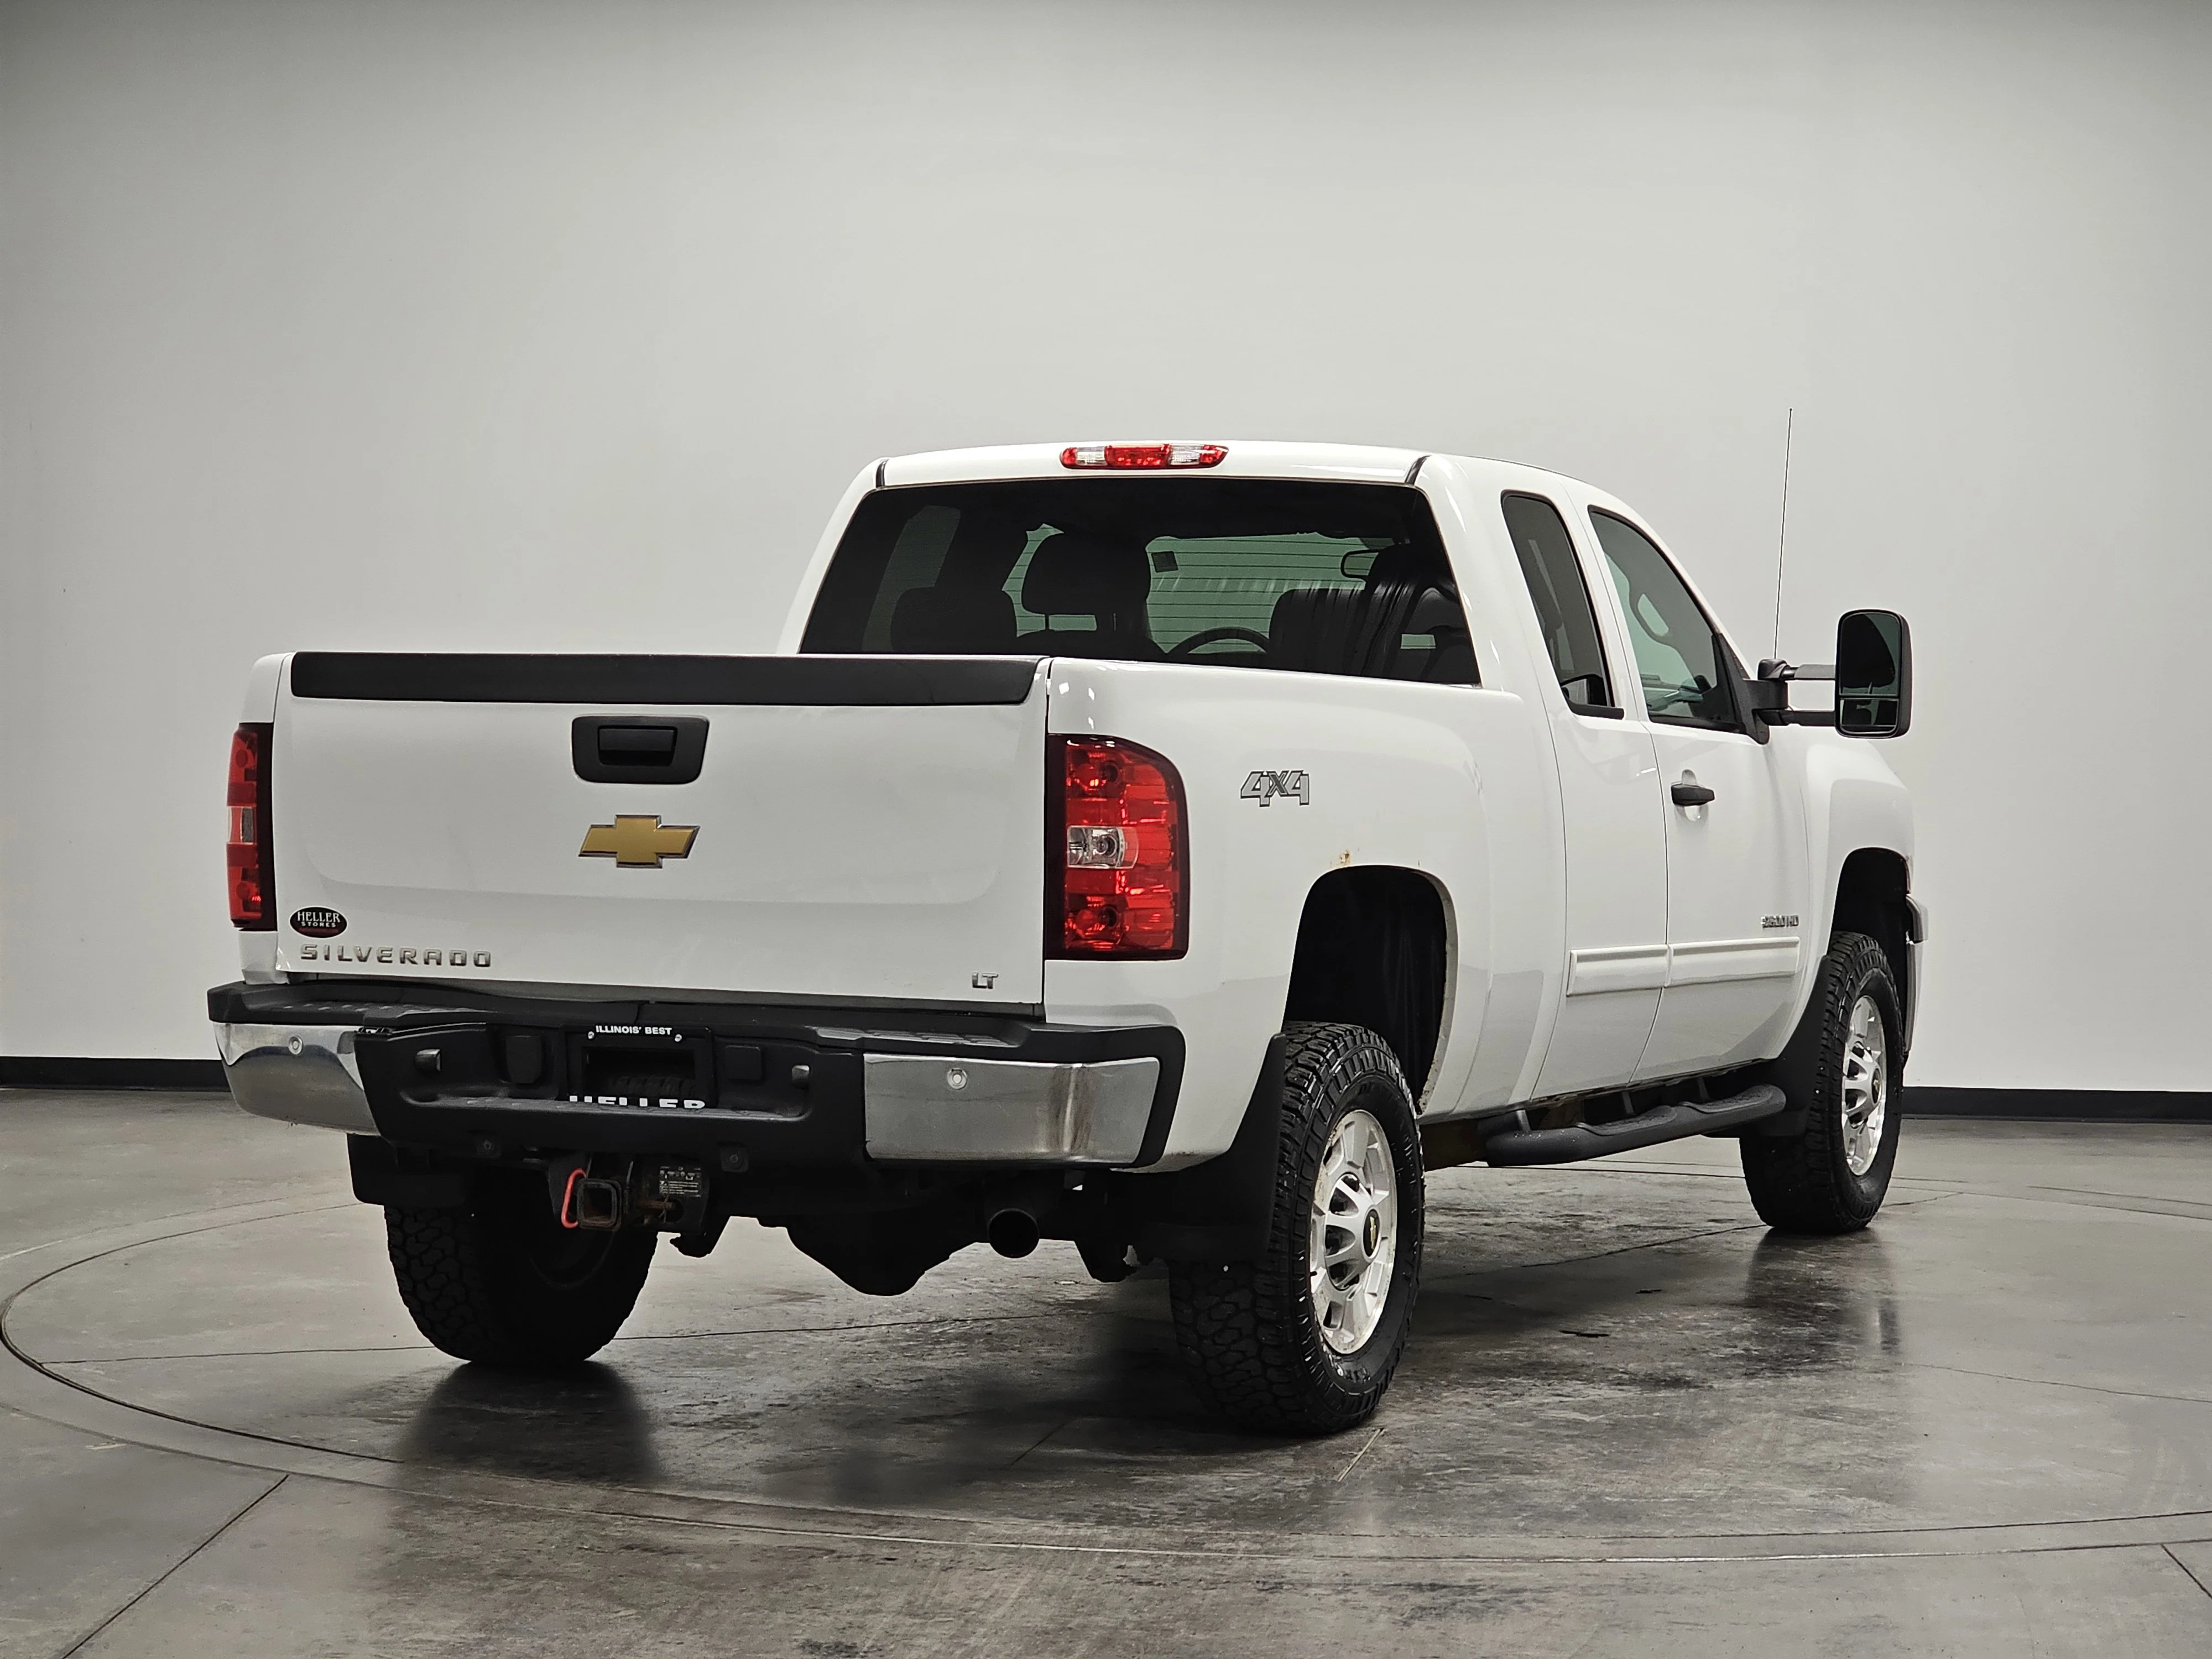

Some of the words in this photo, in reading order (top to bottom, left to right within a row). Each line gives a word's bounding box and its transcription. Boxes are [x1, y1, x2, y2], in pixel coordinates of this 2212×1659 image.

[297, 911, 341, 923] HELLER
[300, 943, 492, 967] SILVERADO
[972, 972, 999, 989] LT
[595, 1025, 642, 1034] ILLINOIS'
[645, 1026, 672, 1036] BEST
